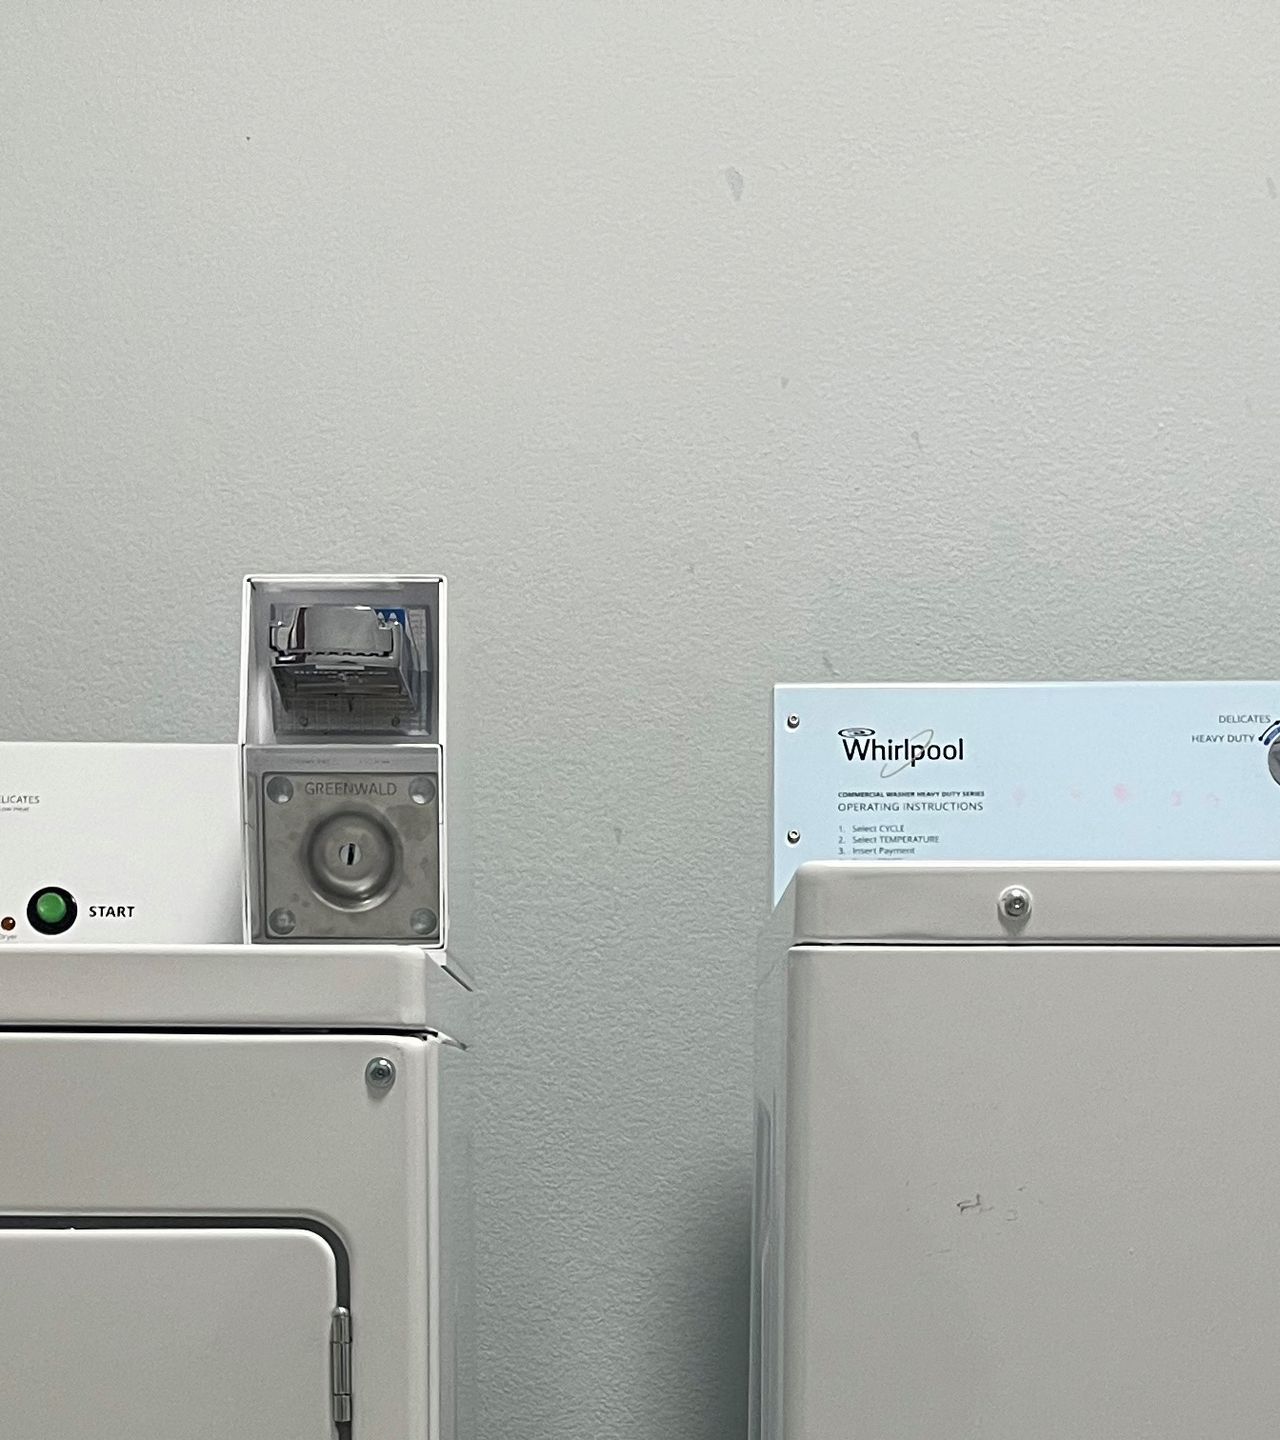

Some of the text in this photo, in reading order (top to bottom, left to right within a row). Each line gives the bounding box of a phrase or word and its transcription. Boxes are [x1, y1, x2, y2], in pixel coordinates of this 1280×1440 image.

[1219, 715, 1271, 723] DELICATES
[1191, 734, 1255, 743] HEAVY DUTY
[842, 738, 965, 767] Whirlpool
[304, 782, 397, 796] GREENWALD
[837, 802, 984, 812] OPERATING INSTRUCTIONS
[852, 825, 877, 833] Select
[879, 825, 905, 833] CYCLE
[852, 836, 877, 844] Select
[879, 836, 939, 844] TEMPERATURE
[879, 847, 915, 856] Payment
[89, 905, 135, 917] START
